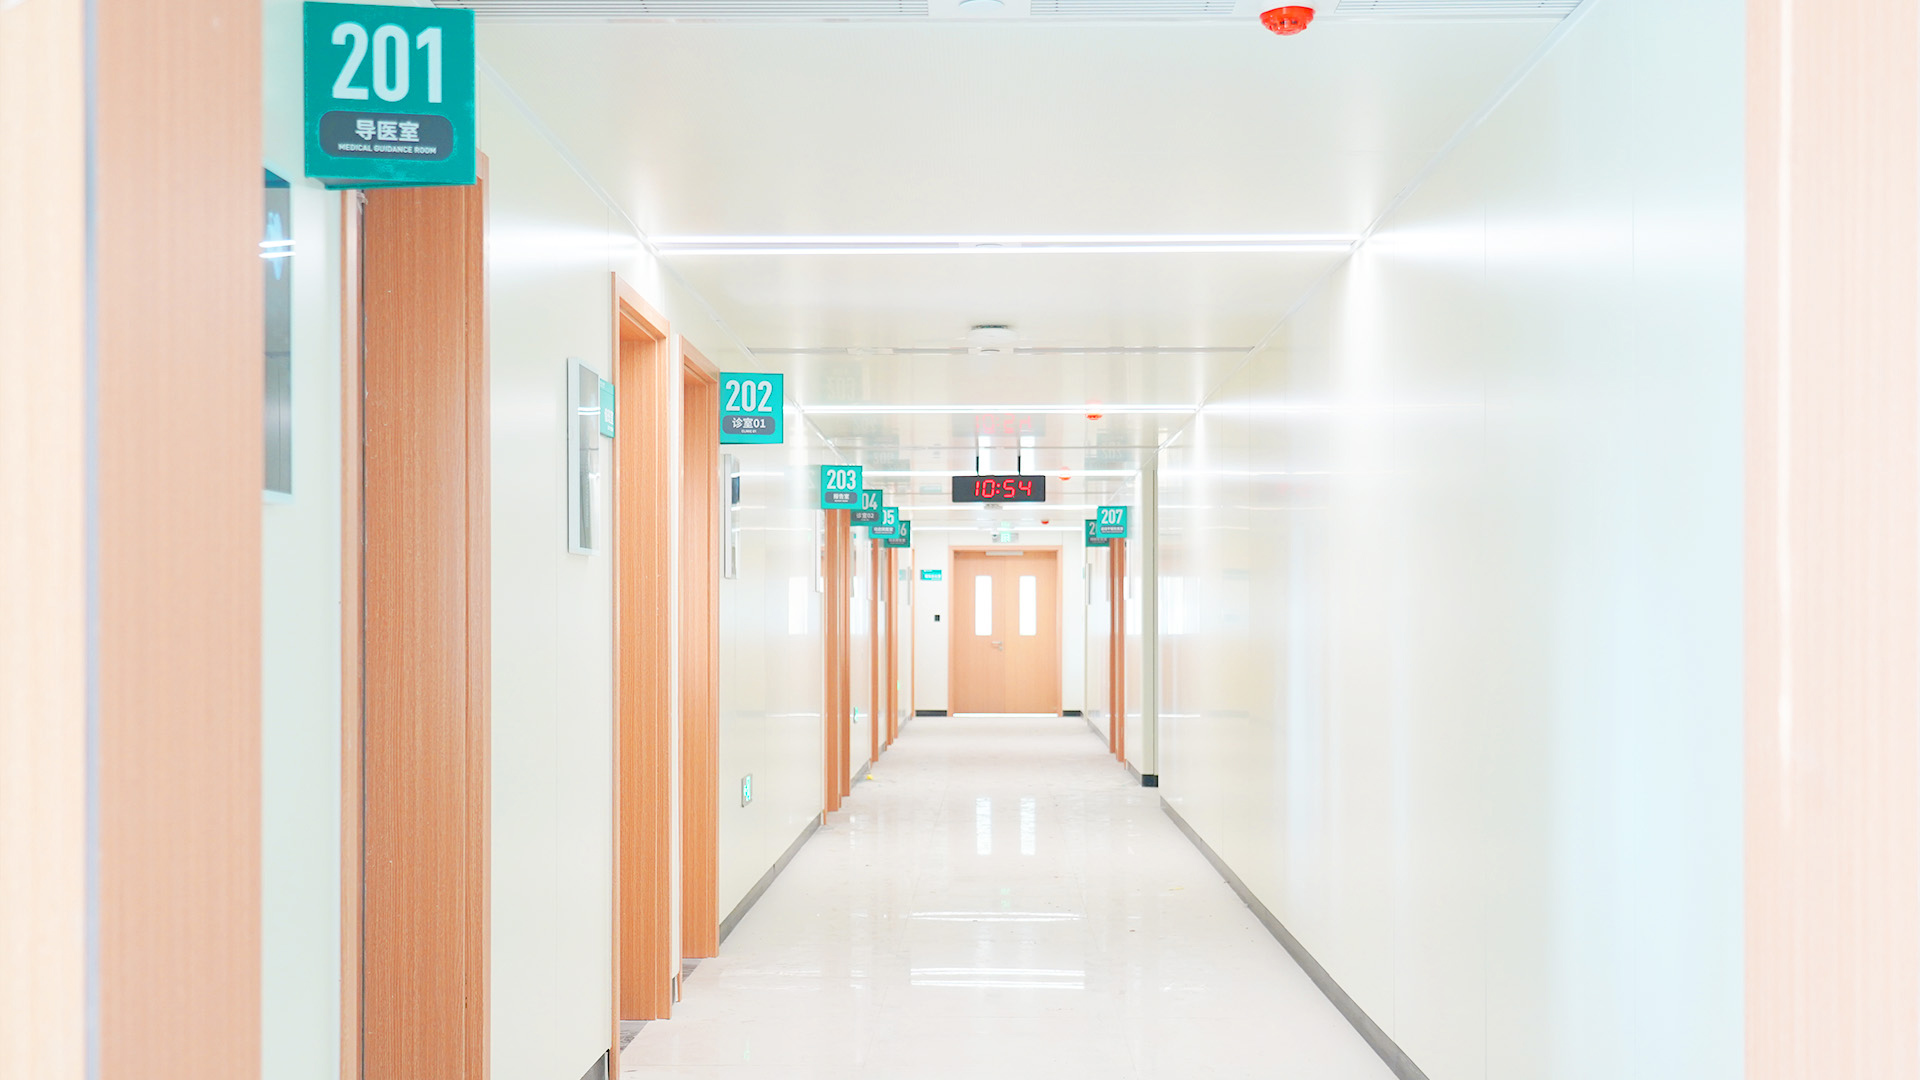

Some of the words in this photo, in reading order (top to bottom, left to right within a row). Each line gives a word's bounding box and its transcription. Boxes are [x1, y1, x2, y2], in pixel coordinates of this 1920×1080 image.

[331, 21, 443, 103] 201
[355, 119, 420, 142] 导医室
[338, 143, 372, 152] MEDICAL
[373, 145, 413, 154] GUIDANCE
[414, 147, 437, 155] ROOM
[726, 380, 773, 411] 202
[732, 417, 766, 429] 诊室01
[826, 469, 856, 490] 203
[974, 479, 1032, 498] 10:54
[862, 493, 878, 510] 04
[1101, 509, 1123, 524] 207
